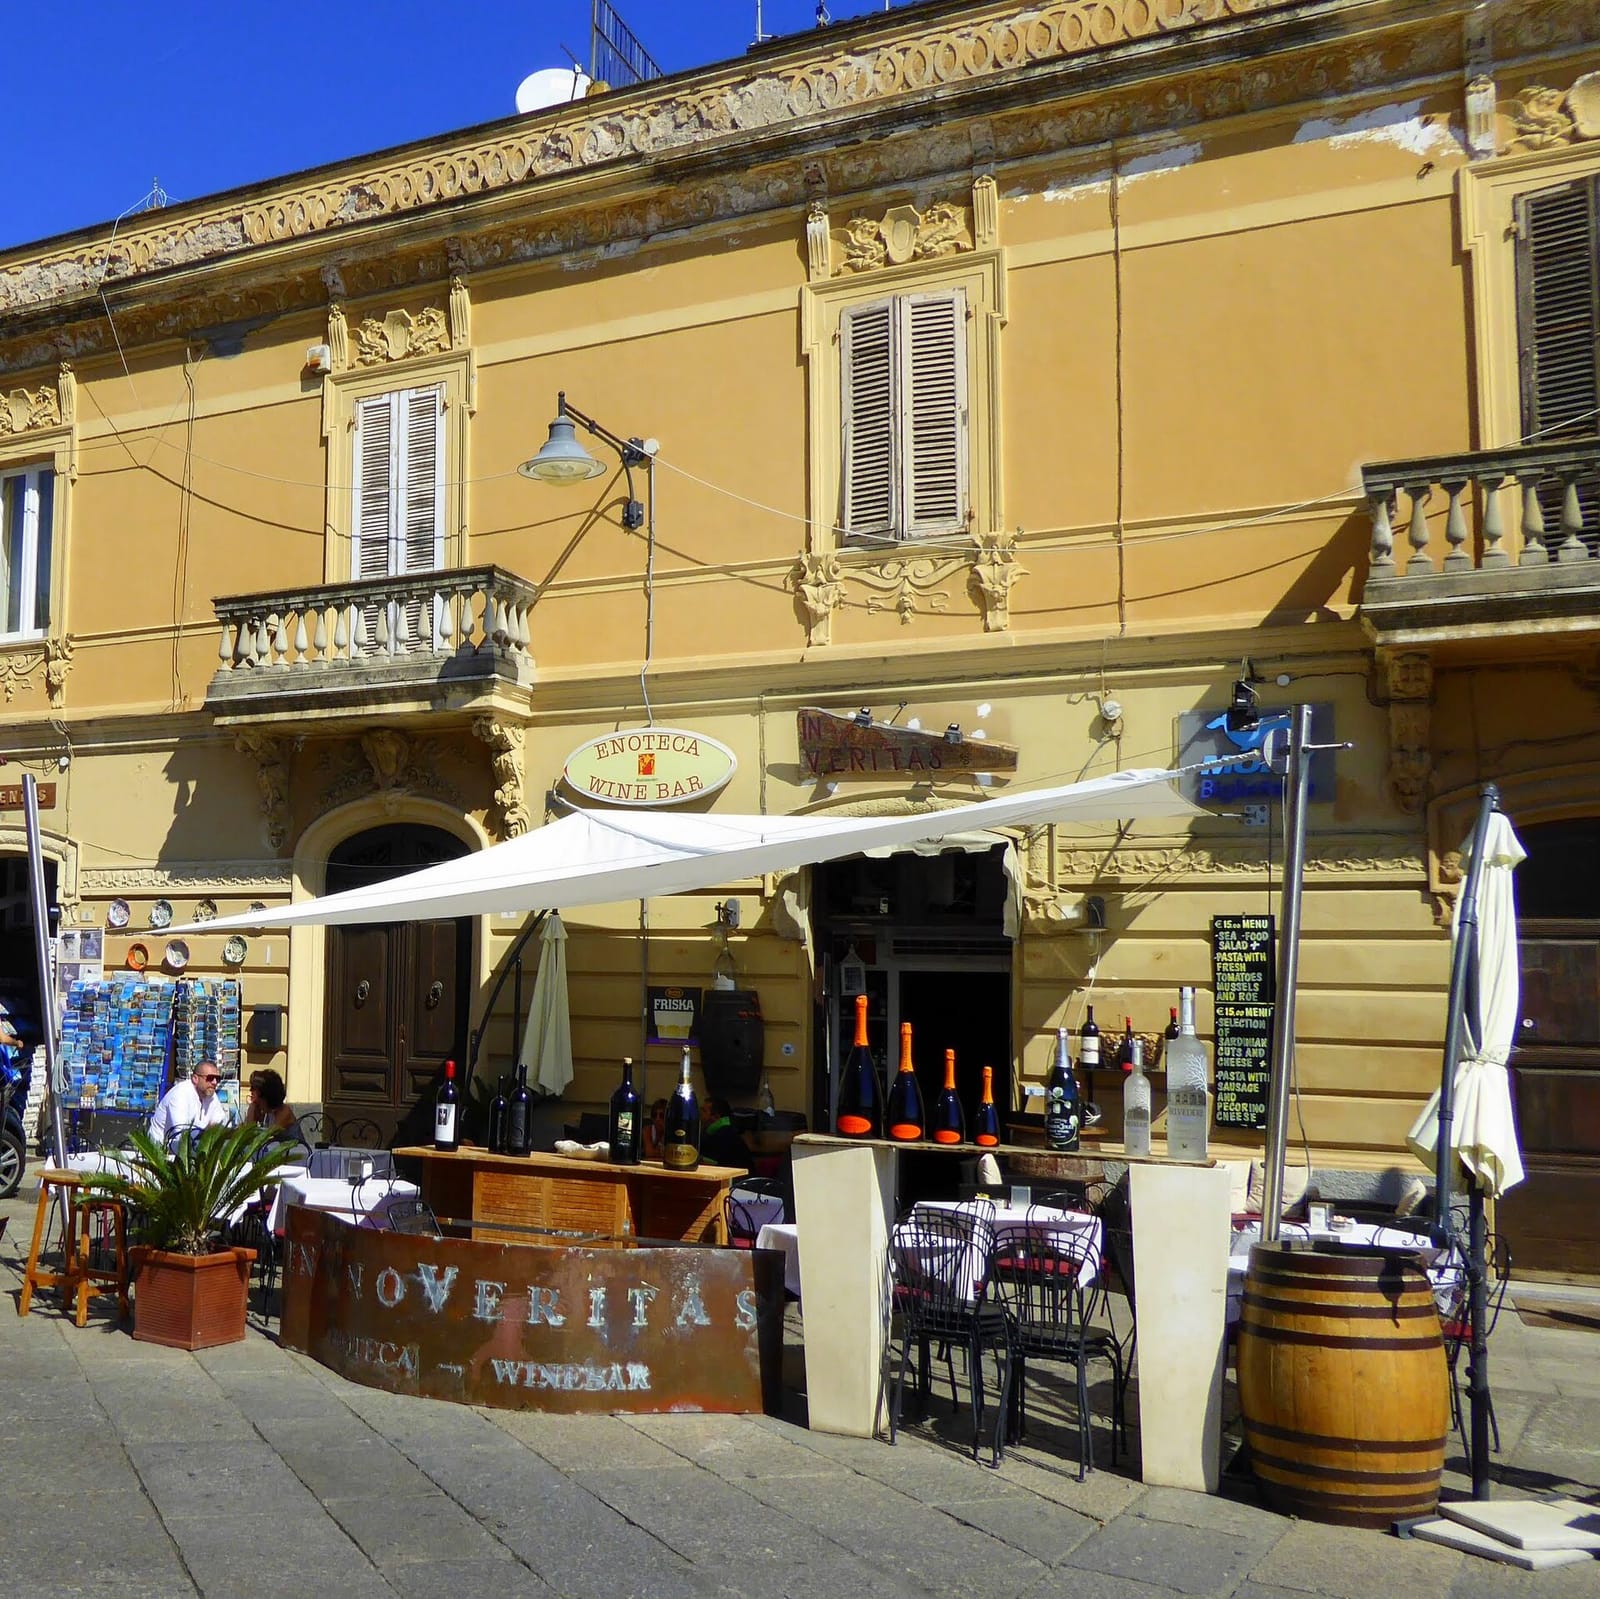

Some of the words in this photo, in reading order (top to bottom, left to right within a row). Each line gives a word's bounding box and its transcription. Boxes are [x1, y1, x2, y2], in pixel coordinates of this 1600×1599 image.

[594, 734, 700, 760] ENOTECA
[805, 746, 943, 773] VERITAS
[589, 775, 647, 800] WINE
[656, 775, 704, 799] BAR
[1242, 919, 1269, 929] MENU
[1218, 940, 1249, 950] SALAD
[1244, 952, 1267, 962] WITH
[1216, 962, 1246, 972] FRESH
[1216, 972, 1263, 982] TOMATOES
[1216, 982, 1260, 992] MUSSELS
[1216, 991, 1235, 1001] AND
[1238, 992, 1258, 1001] ROE
[653, 998, 695, 1011] FRISKA
[1217, 1028, 1230, 1037] OF
[1217, 1046, 1243, 1057] CUTS
[1245, 1048, 1266, 1058] AND
[1217, 1057, 1253, 1067] CHEESE
[1217, 1082, 1260, 1093] SAUSAGE
[1217, 1092, 1237, 1102] AND
[1217, 1102, 1266, 1113] PECORINO
[1216, 1112, 1257, 1122] CHEESE
